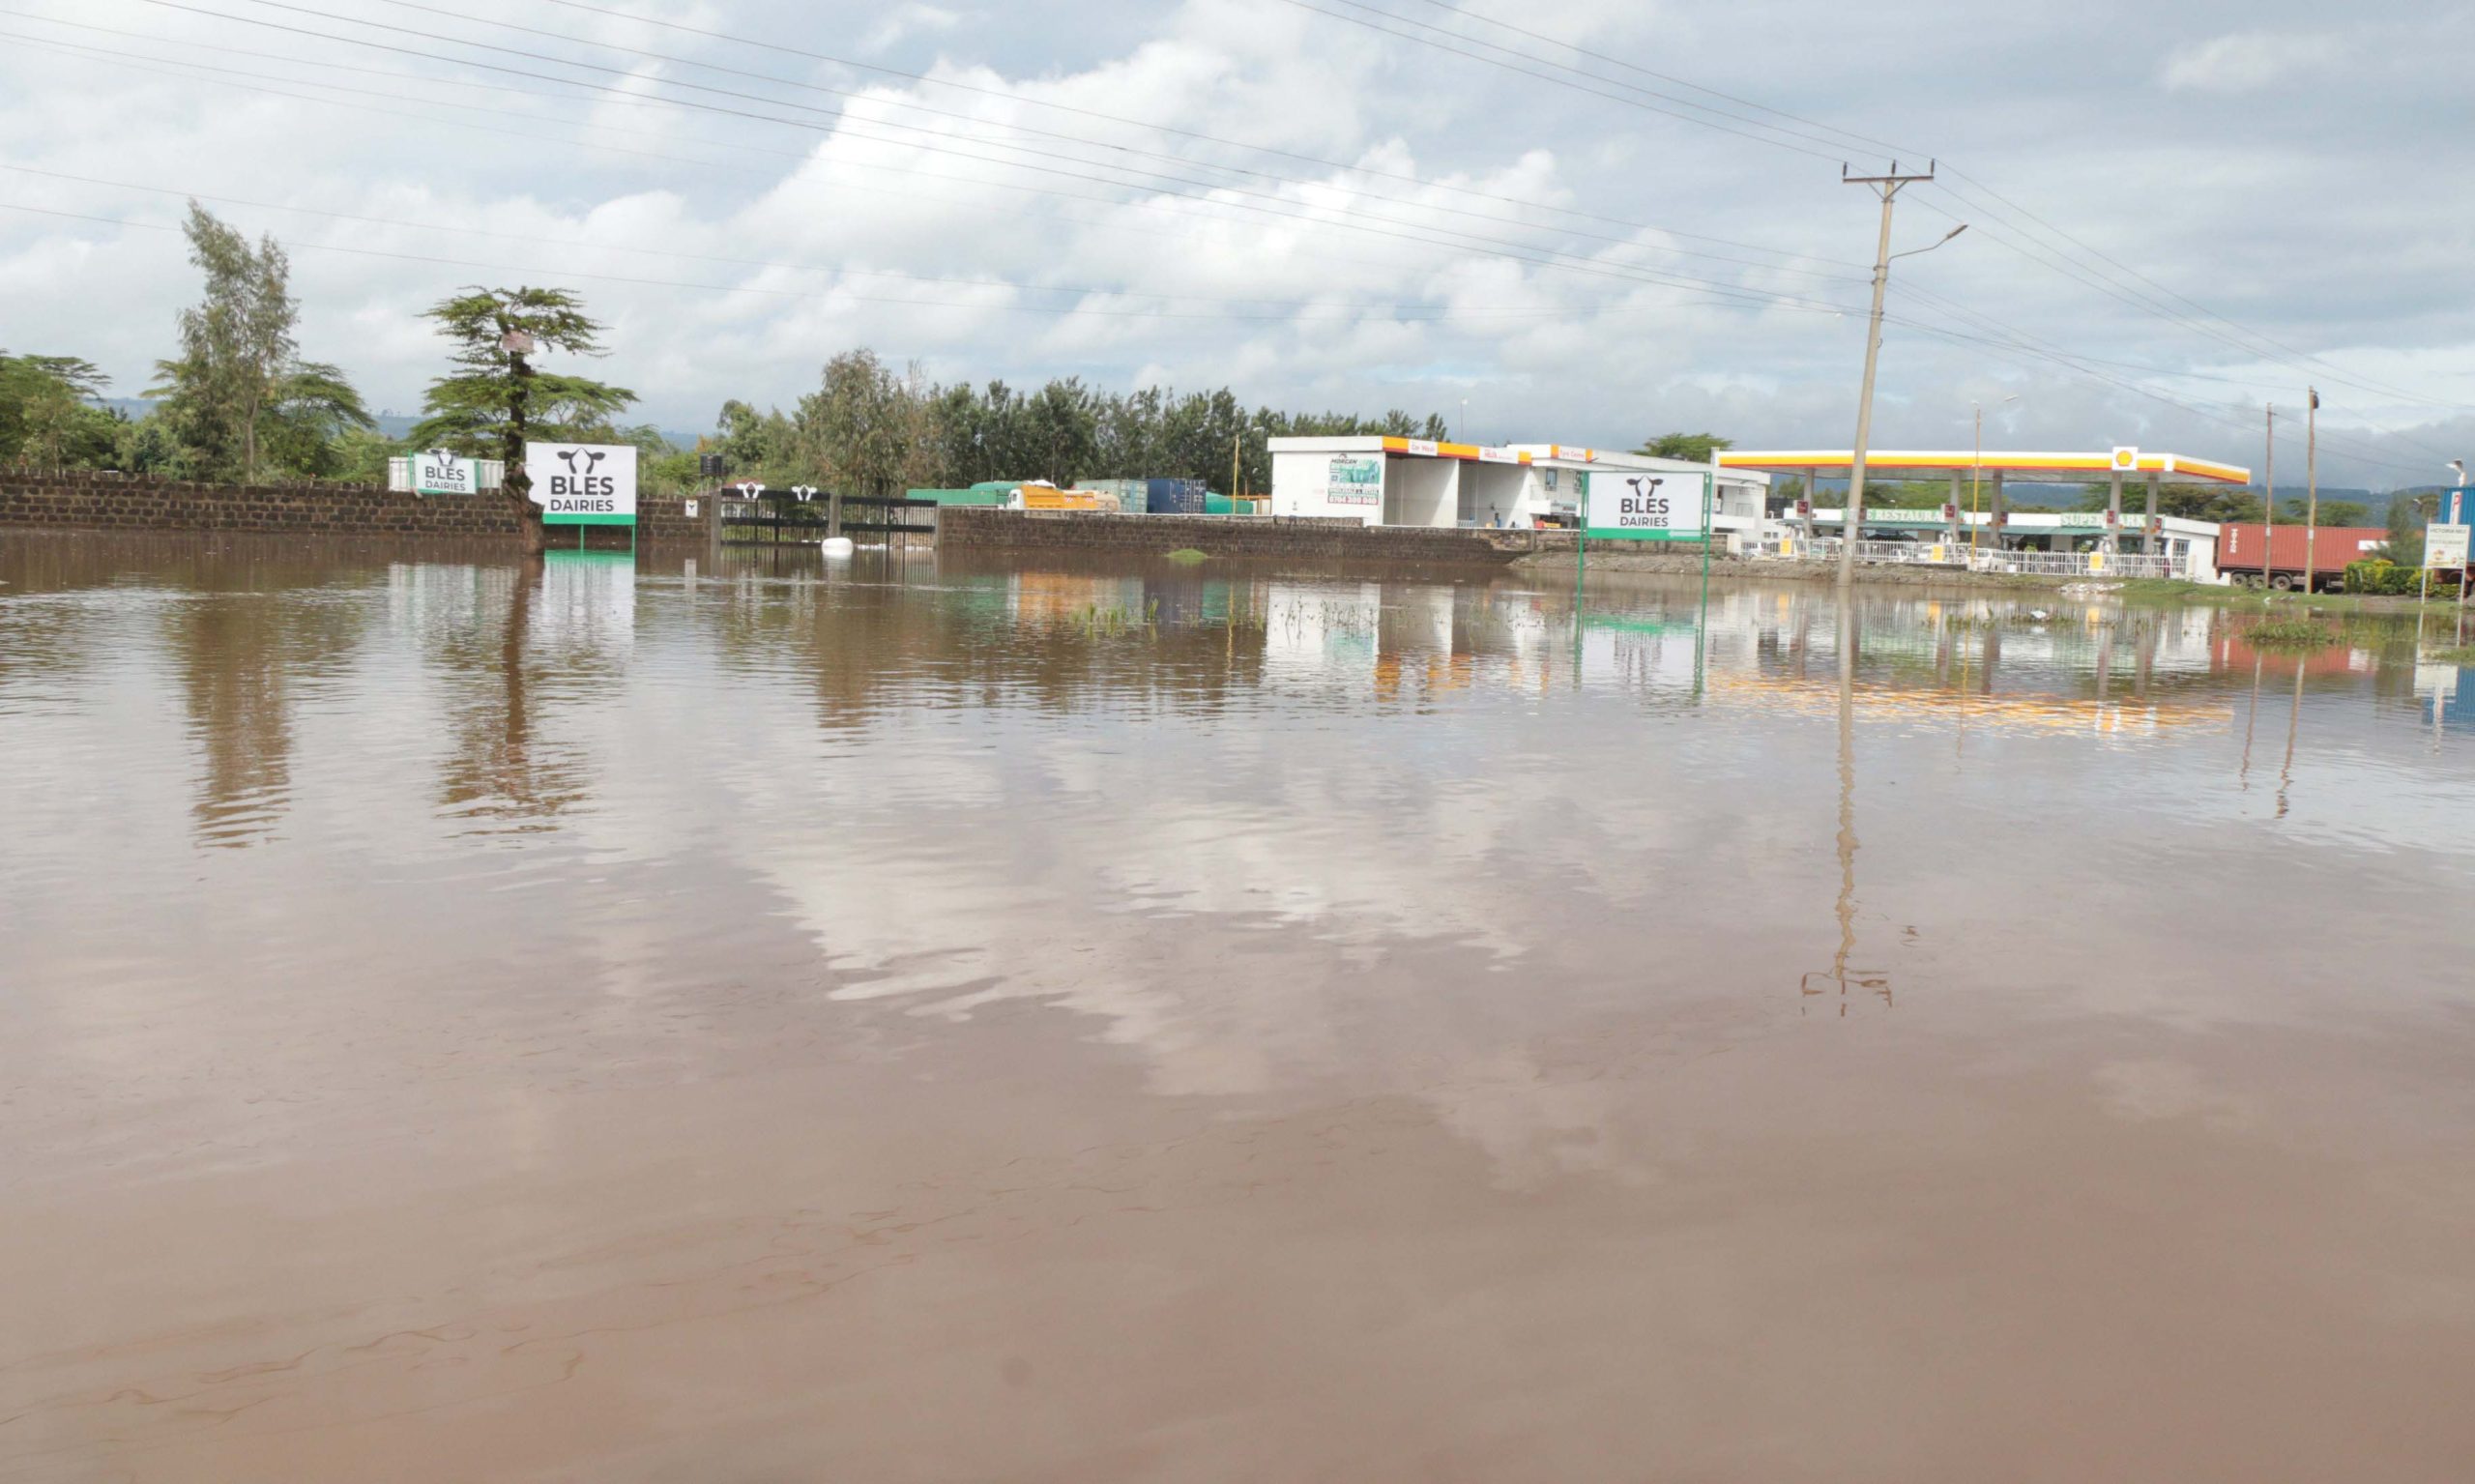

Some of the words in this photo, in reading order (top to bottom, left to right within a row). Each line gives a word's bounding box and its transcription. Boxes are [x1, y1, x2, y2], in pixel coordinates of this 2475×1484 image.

[425, 466, 465, 480] BLES
[425, 480, 466, 491] DAIRIES
[550, 476, 614, 495] BLES
[550, 499, 614, 511] DAIRIES
[1620, 498, 1670, 514] BLES
[1619, 516, 1669, 527] DAIRIES
